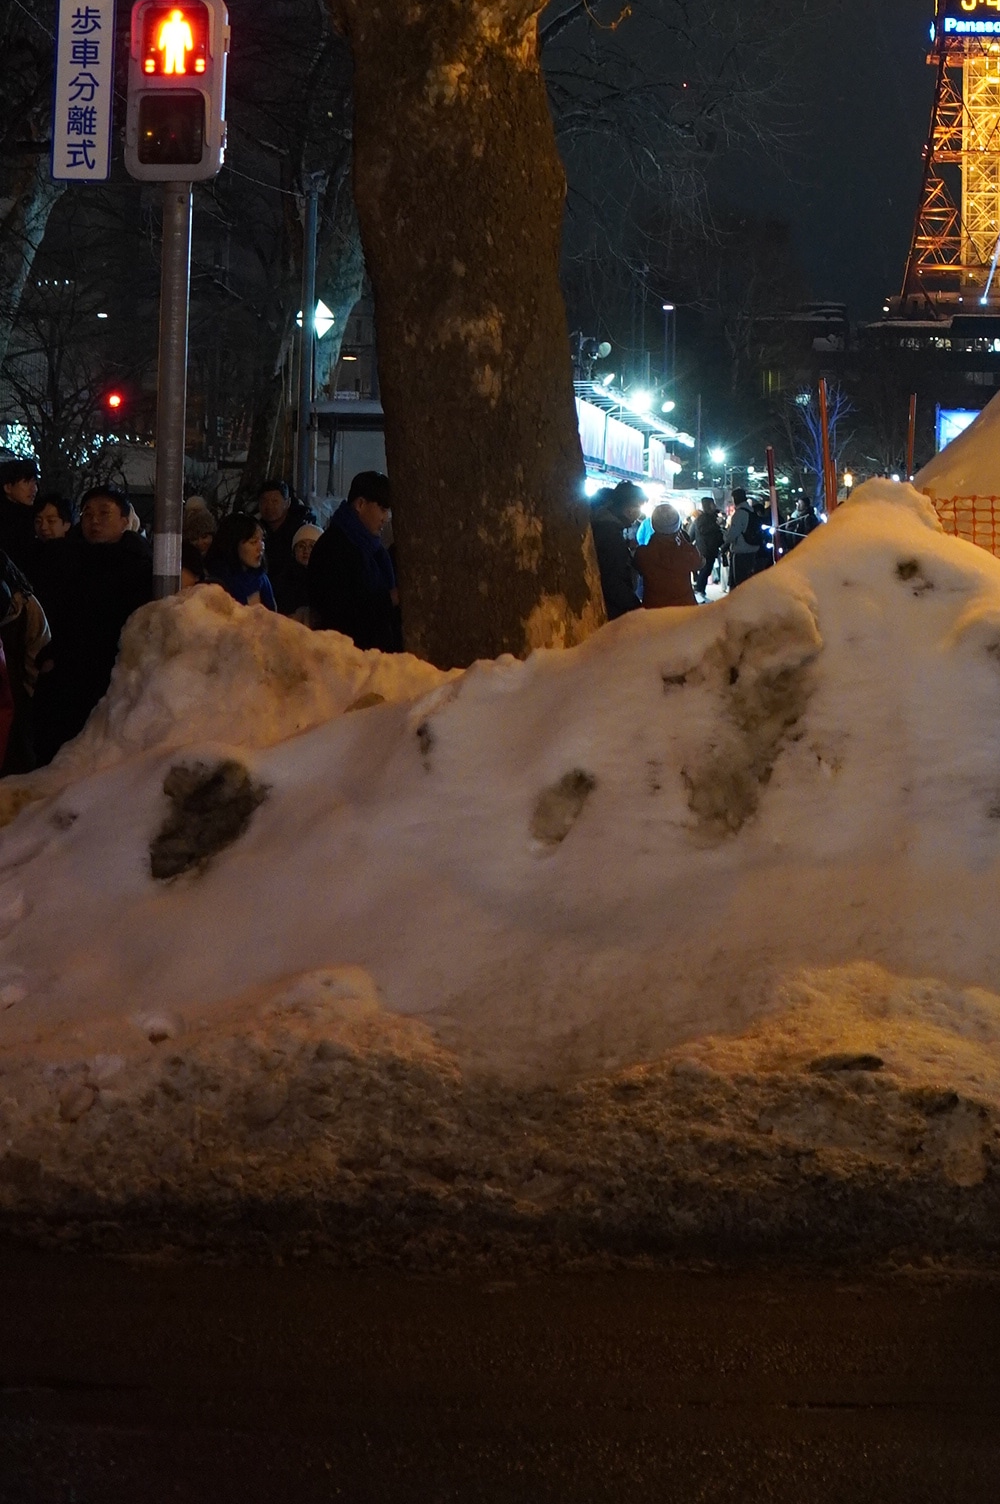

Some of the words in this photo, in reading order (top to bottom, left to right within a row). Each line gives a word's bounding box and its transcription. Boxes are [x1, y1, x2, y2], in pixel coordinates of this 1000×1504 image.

[66, 6, 102, 170] 歩車分離式
